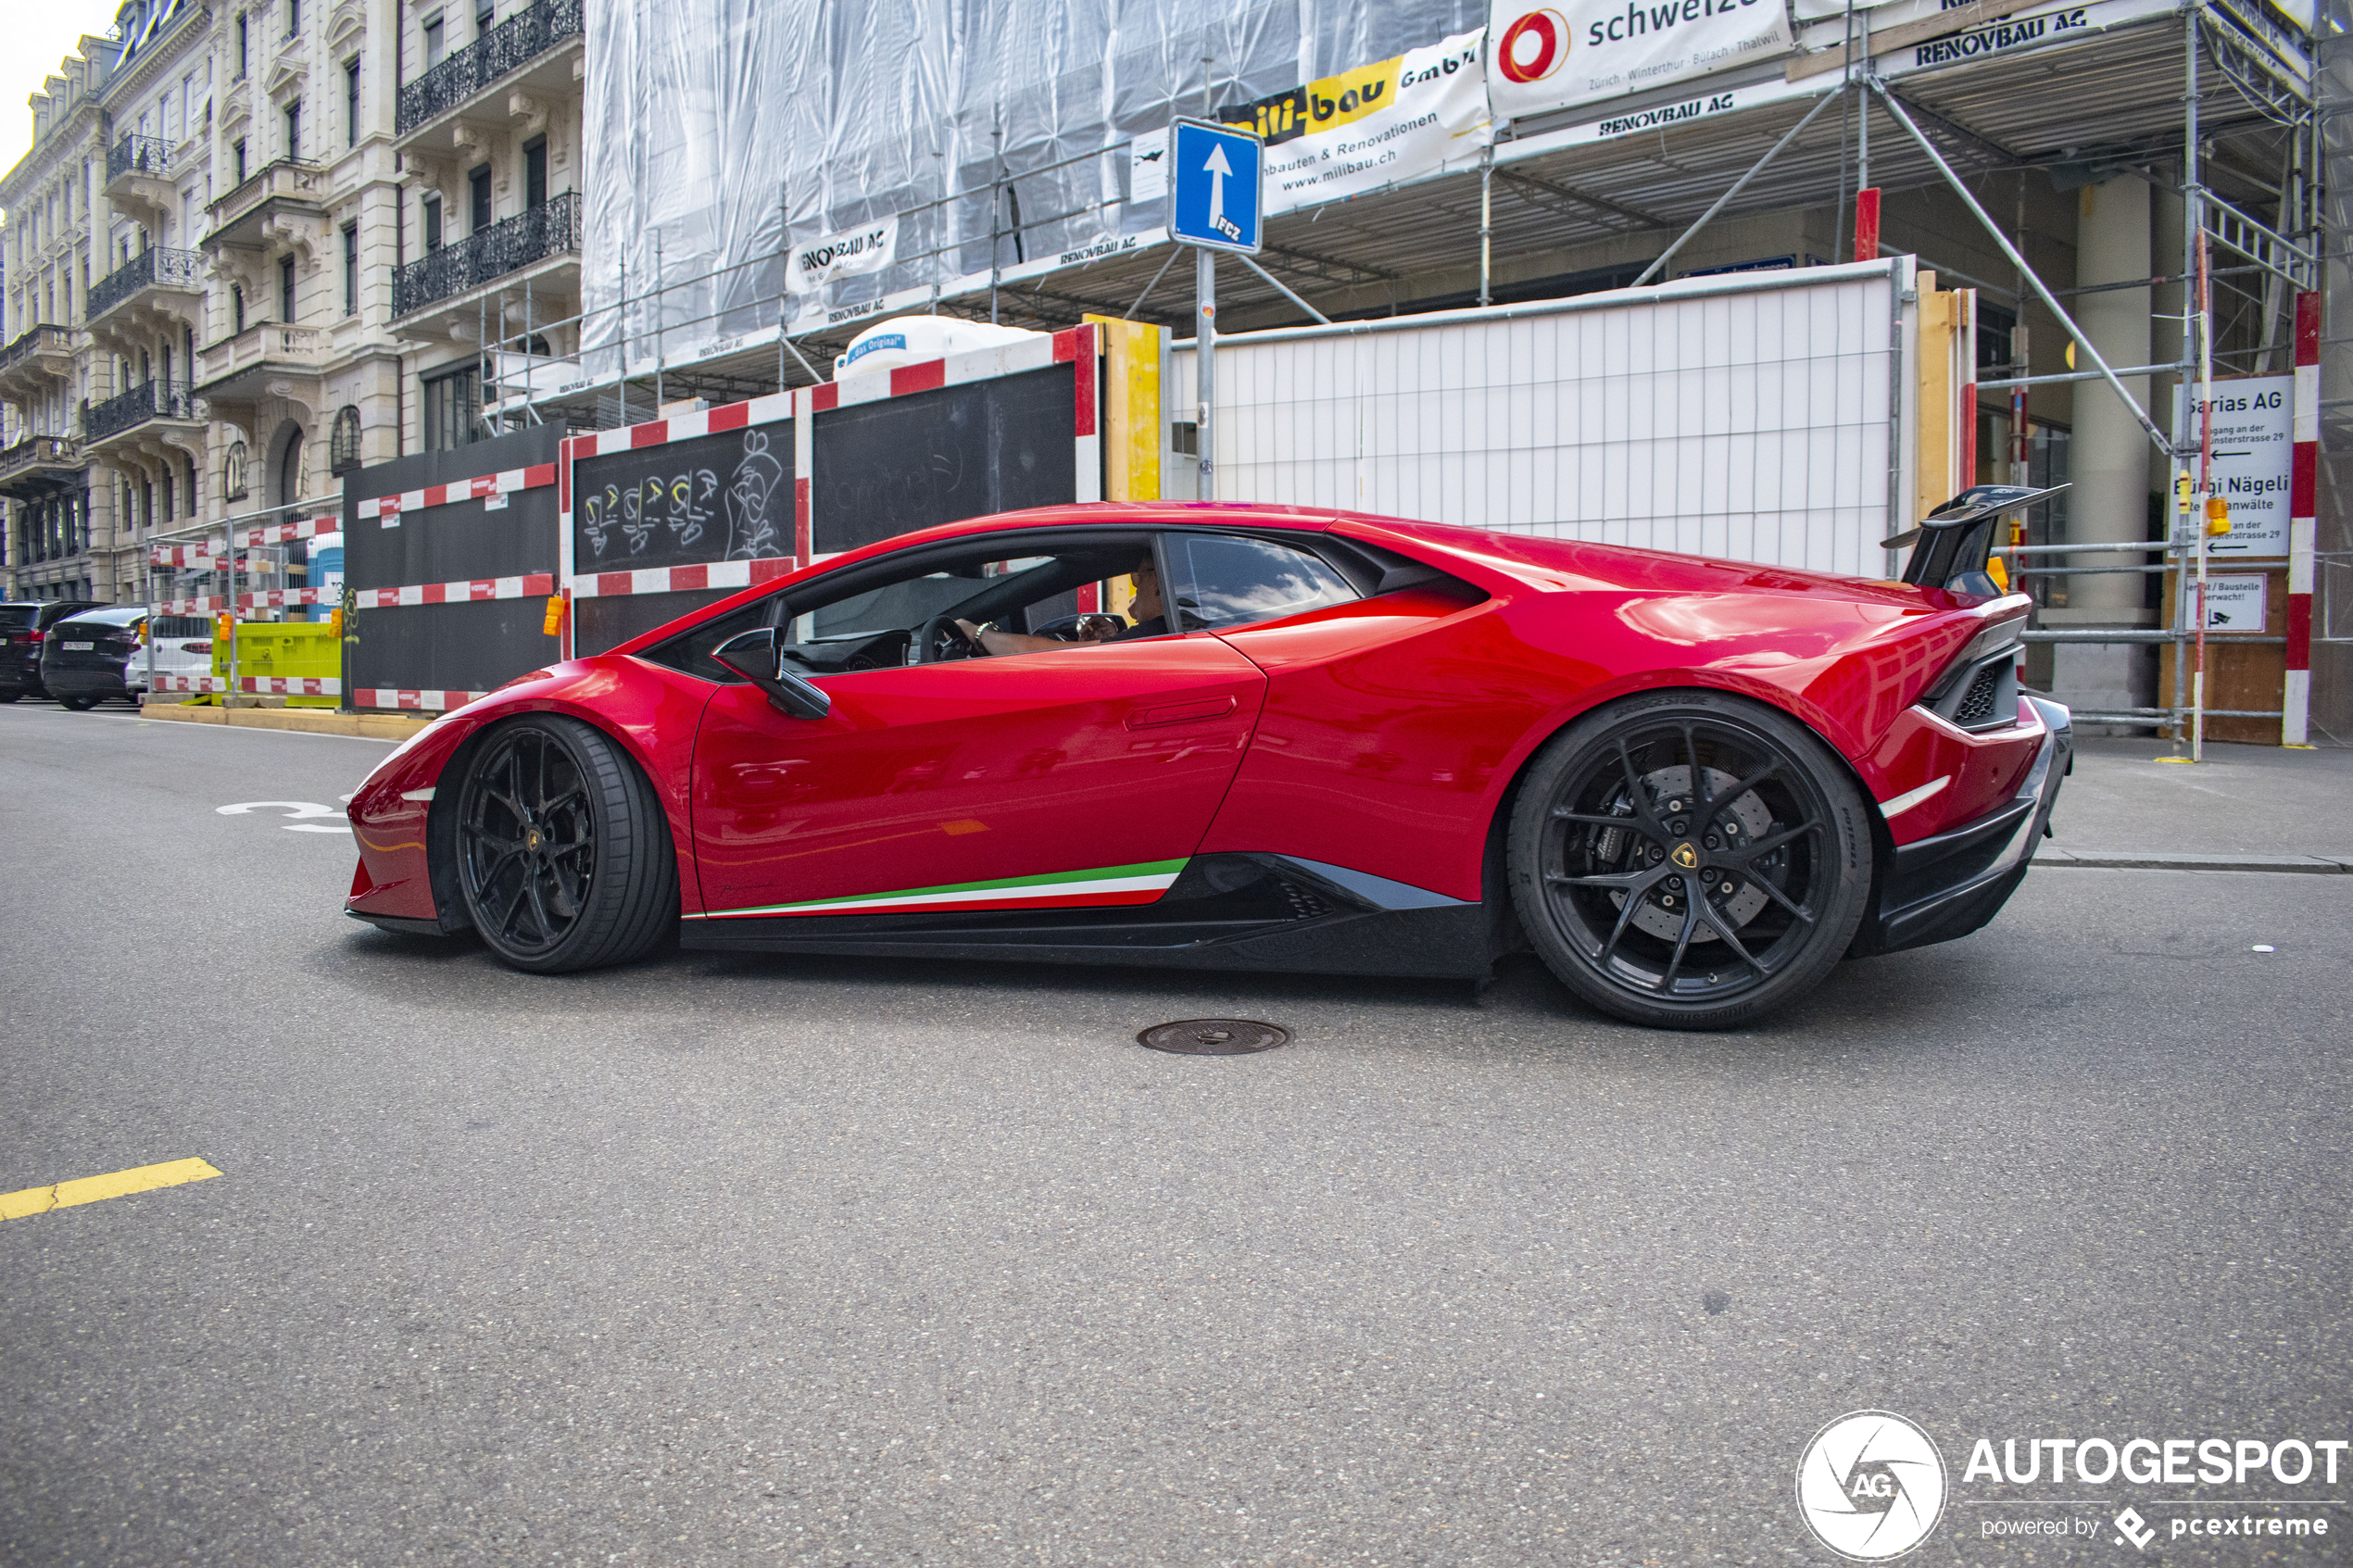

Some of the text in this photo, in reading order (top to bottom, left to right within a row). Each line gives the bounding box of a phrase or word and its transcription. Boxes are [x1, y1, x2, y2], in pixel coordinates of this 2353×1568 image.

[1589, 0, 1757, 47] schweiz
[1916, 9, 2087, 67] RENOVBAU AG
[1400, 47, 1477, 89] GmbH
[1589, 31, 1780, 91] Zürich Winterthur Bülach Thalwil
[1598, 94, 1734, 137] RENOVBAU AG
[1321, 148, 1330, 160] &
[1337, 111, 1438, 157] Renovationen
[1282, 149, 1397, 191] www.milibau.ch
[1217, 216, 1242, 241] FCZ
[802, 230, 884, 271] ENOVBAU AG
[1061, 235, 1137, 265] RENOVBAU AG
[828, 298, 885, 323] RENOVBAU AG
[2252, 391, 2282, 409] AG
[2199, 427, 2233, 435] Egang
[2249, 424, 2265, 433] der
[2272, 433, 2284, 442] 29
[2228, 474, 2288, 495] Nägeli
[2246, 521, 2261, 529] der
[2219, 583, 2260, 591] Baustelle
